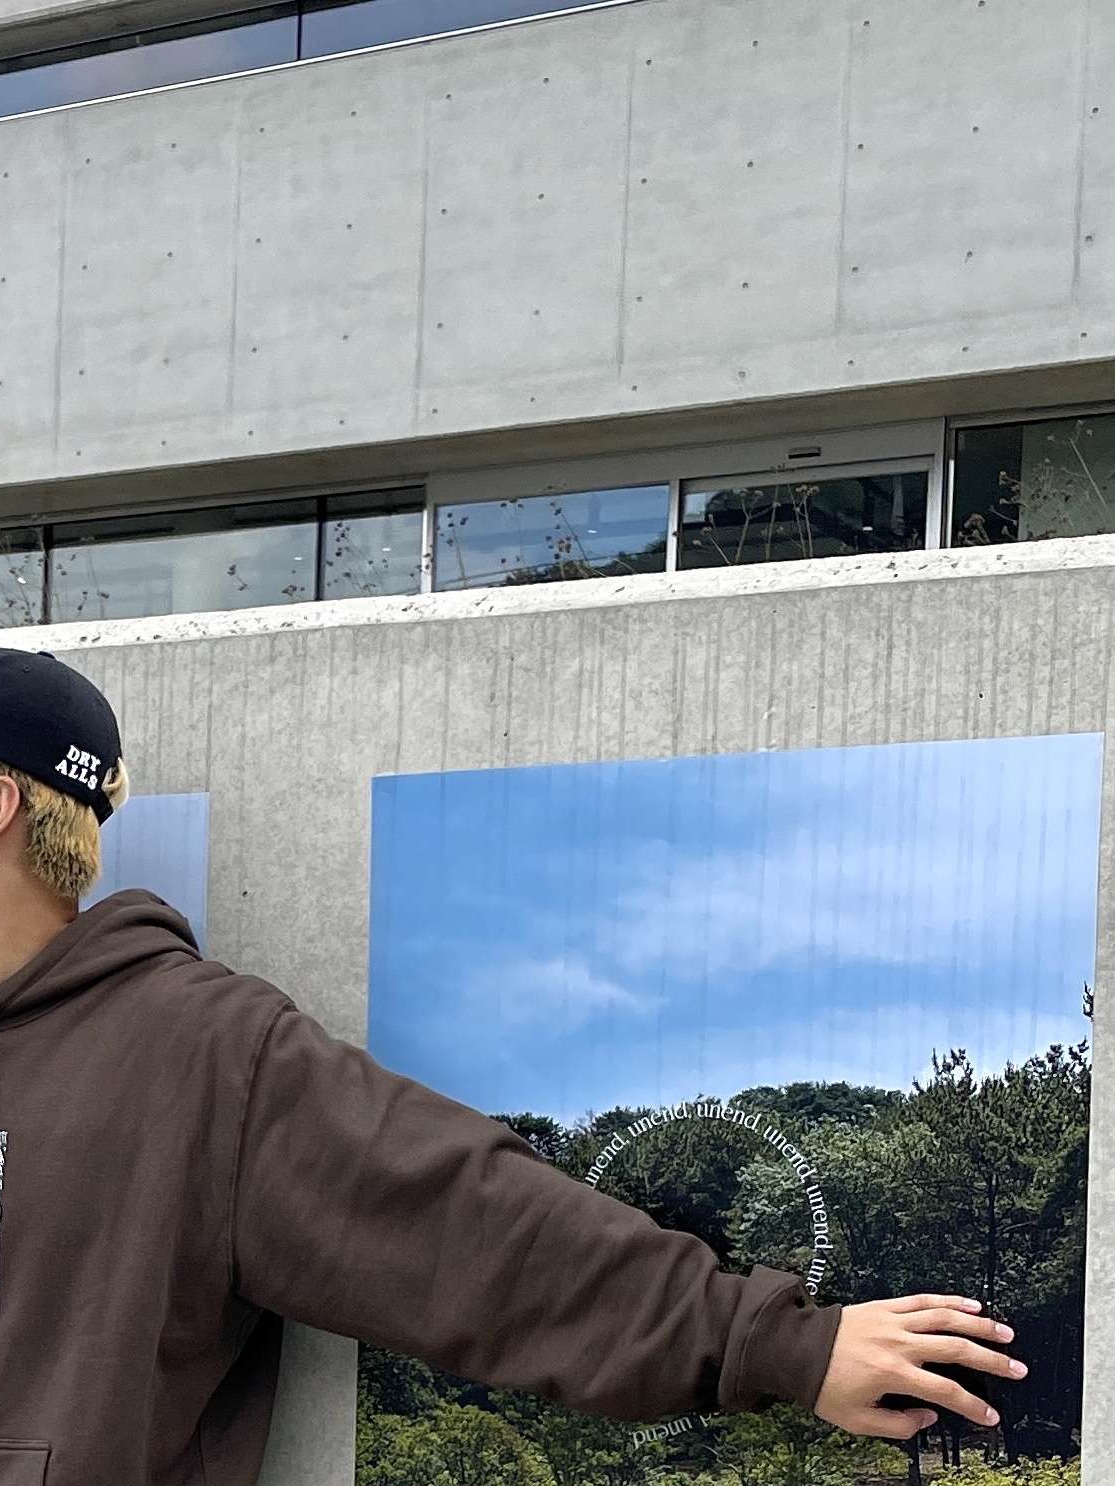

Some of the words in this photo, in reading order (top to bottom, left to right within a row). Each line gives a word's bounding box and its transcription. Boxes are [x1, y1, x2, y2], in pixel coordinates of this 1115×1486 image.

[66, 744, 101, 772] DRY
[54, 759, 98, 790] ALLS
[805, 1257, 827, 1296] une
